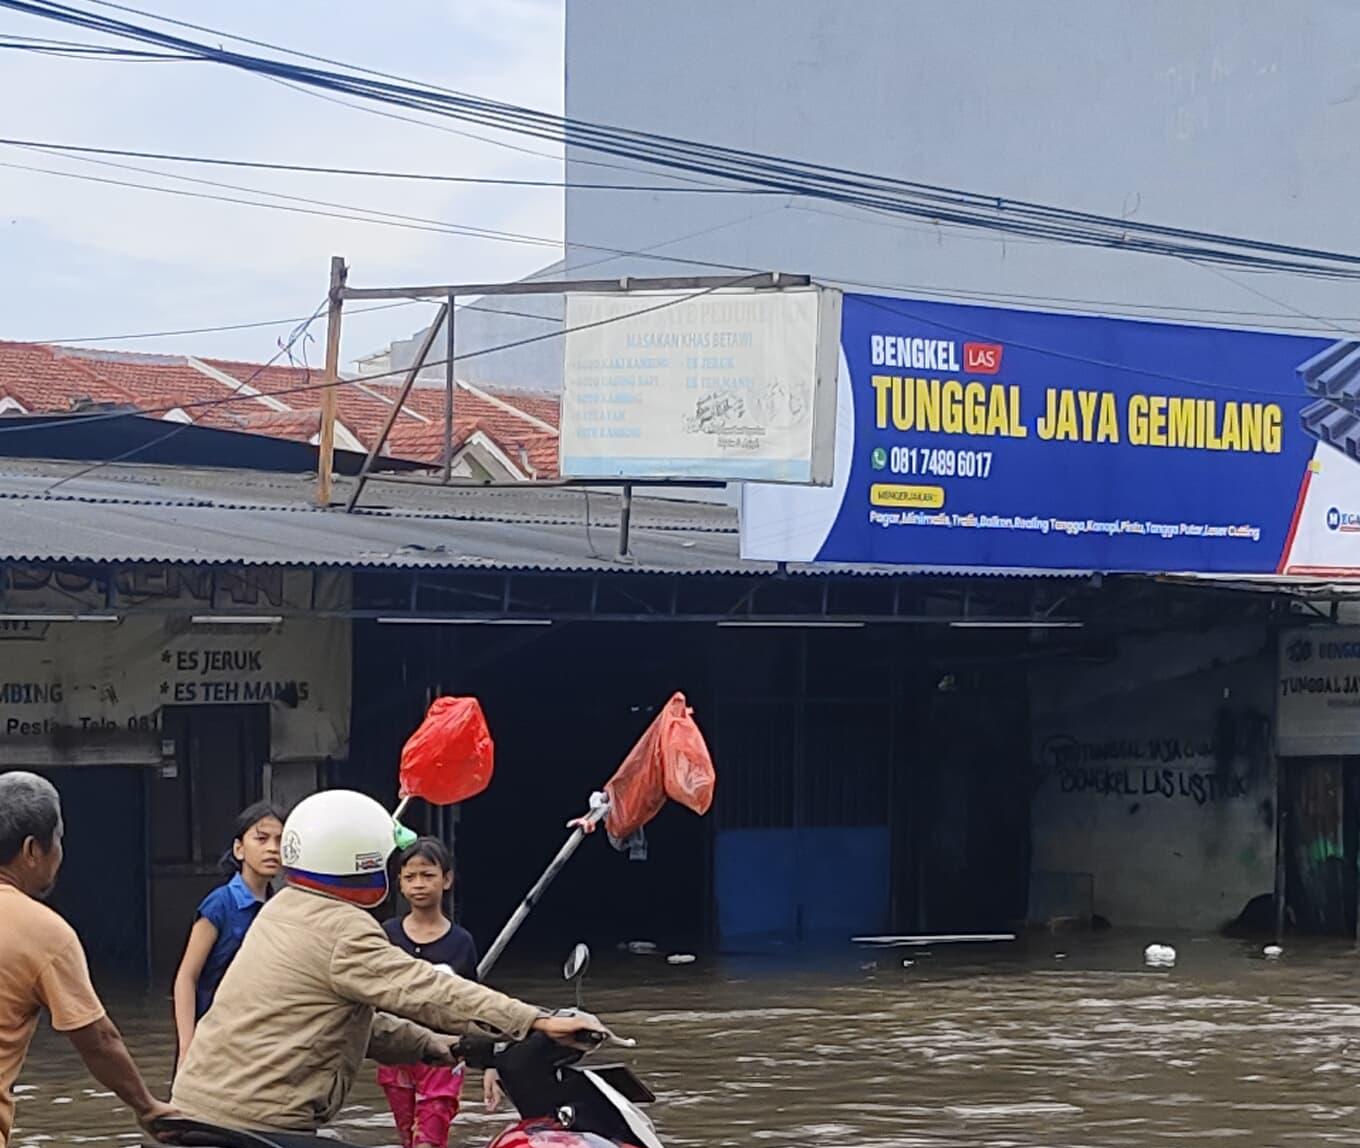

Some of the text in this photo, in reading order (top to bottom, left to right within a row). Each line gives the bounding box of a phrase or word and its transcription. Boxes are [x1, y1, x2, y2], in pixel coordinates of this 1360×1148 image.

[871, 334, 996, 373] BENGKEL LAS
[871, 374, 1283, 454] TUNGGAL JAYA GEMILANG
[890, 446, 992, 478] 081 7489 6017
[176, 650, 262, 674] ES JERUK
[175, 682, 309, 702] ES TEH MANS
